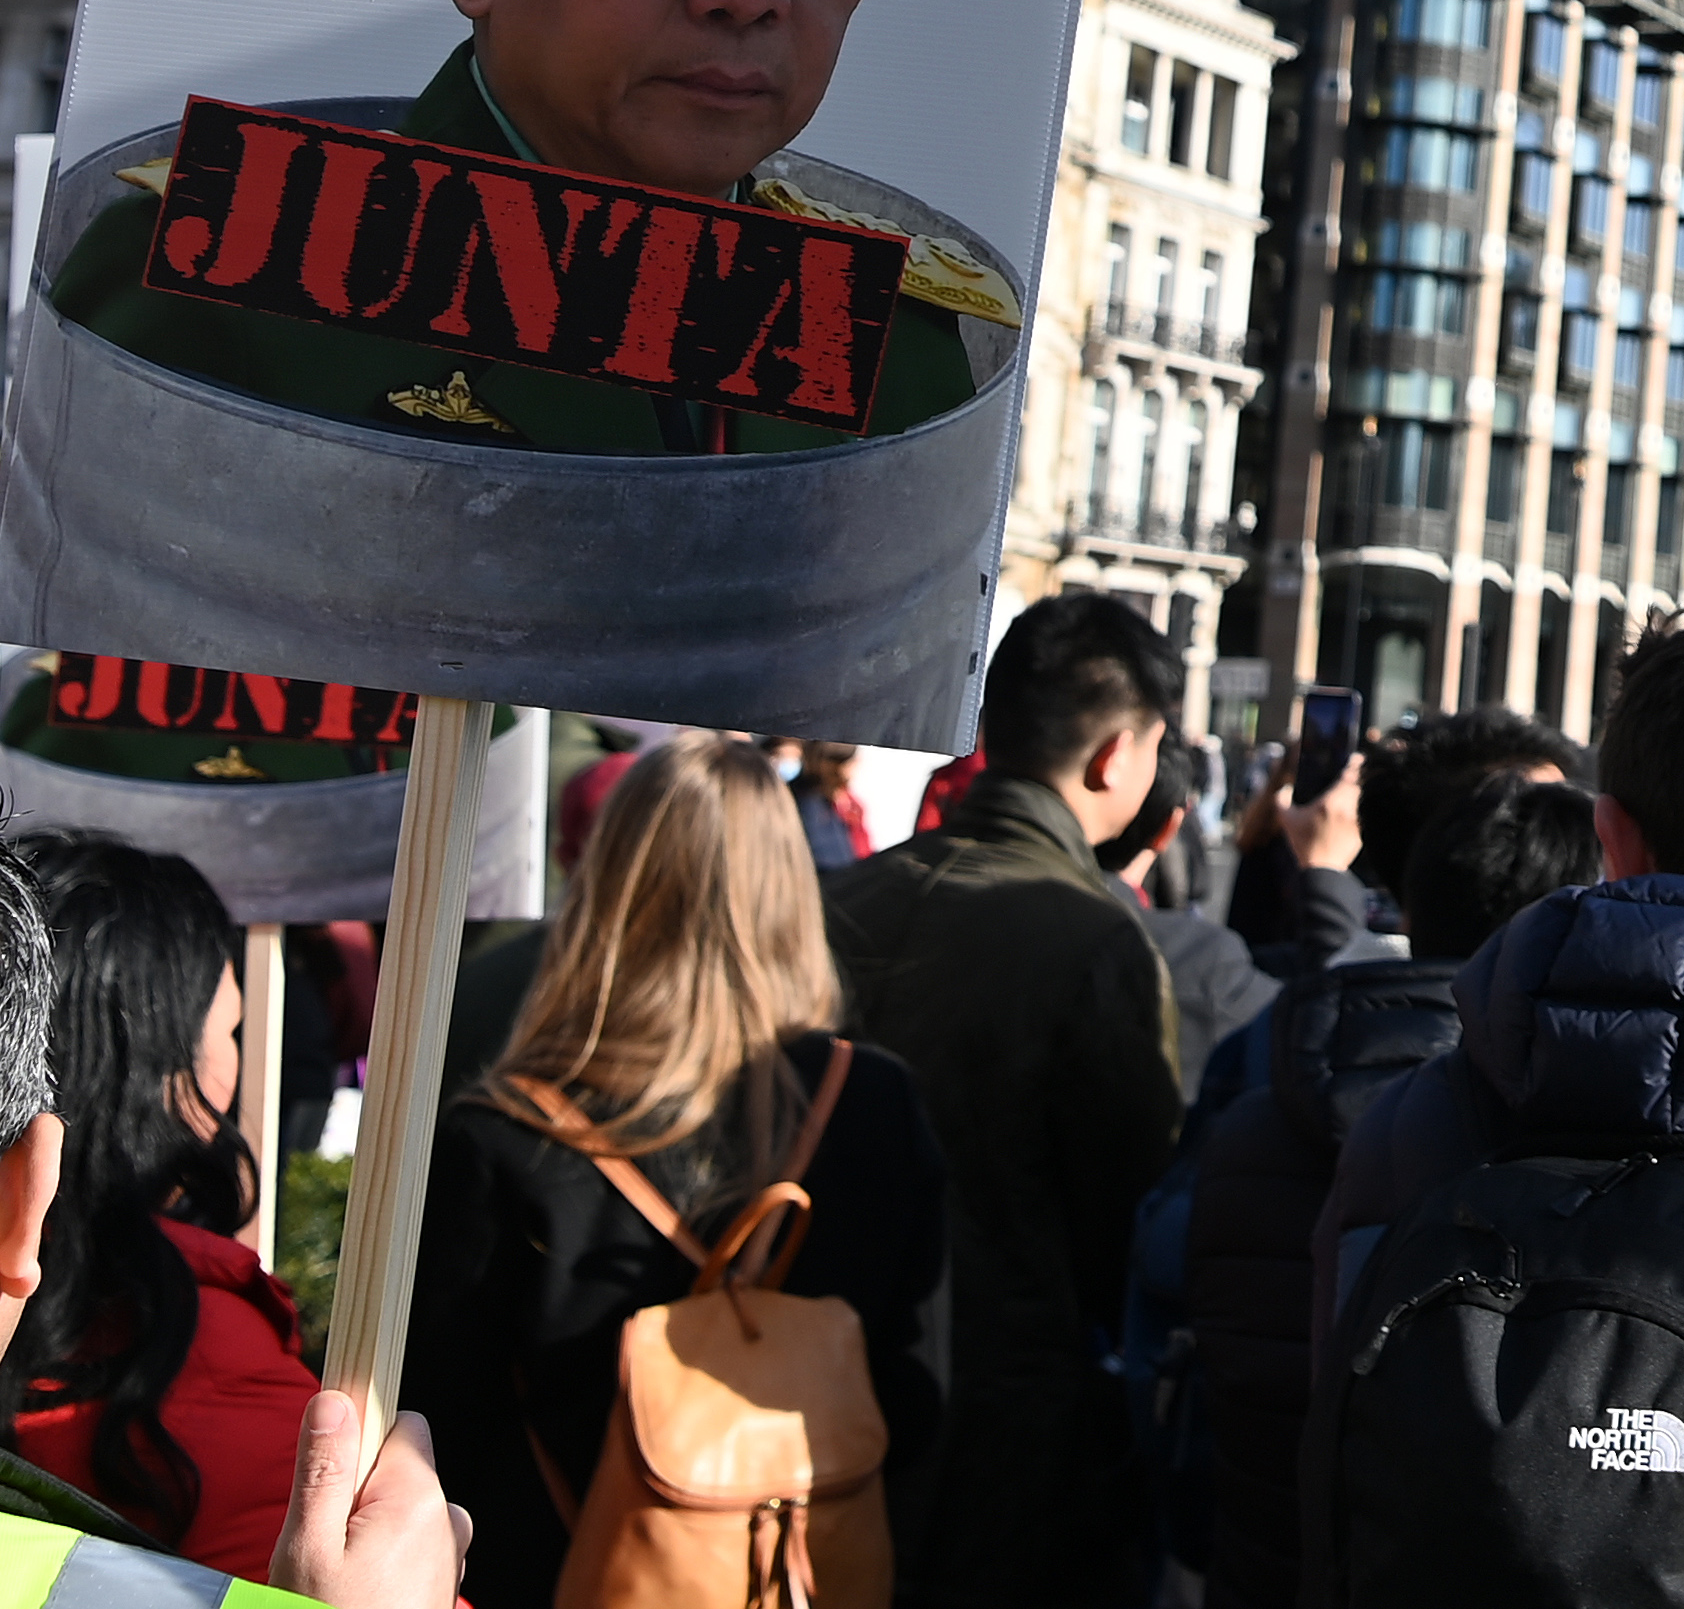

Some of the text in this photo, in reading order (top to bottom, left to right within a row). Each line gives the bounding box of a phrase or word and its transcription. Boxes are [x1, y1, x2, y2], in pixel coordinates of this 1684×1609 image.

[163, 124, 857, 416] JUNTA
[1606, 1407, 1654, 1430] THE
[1569, 1427, 1651, 1450] NORTH
[1591, 1448, 1650, 1471] FACE
